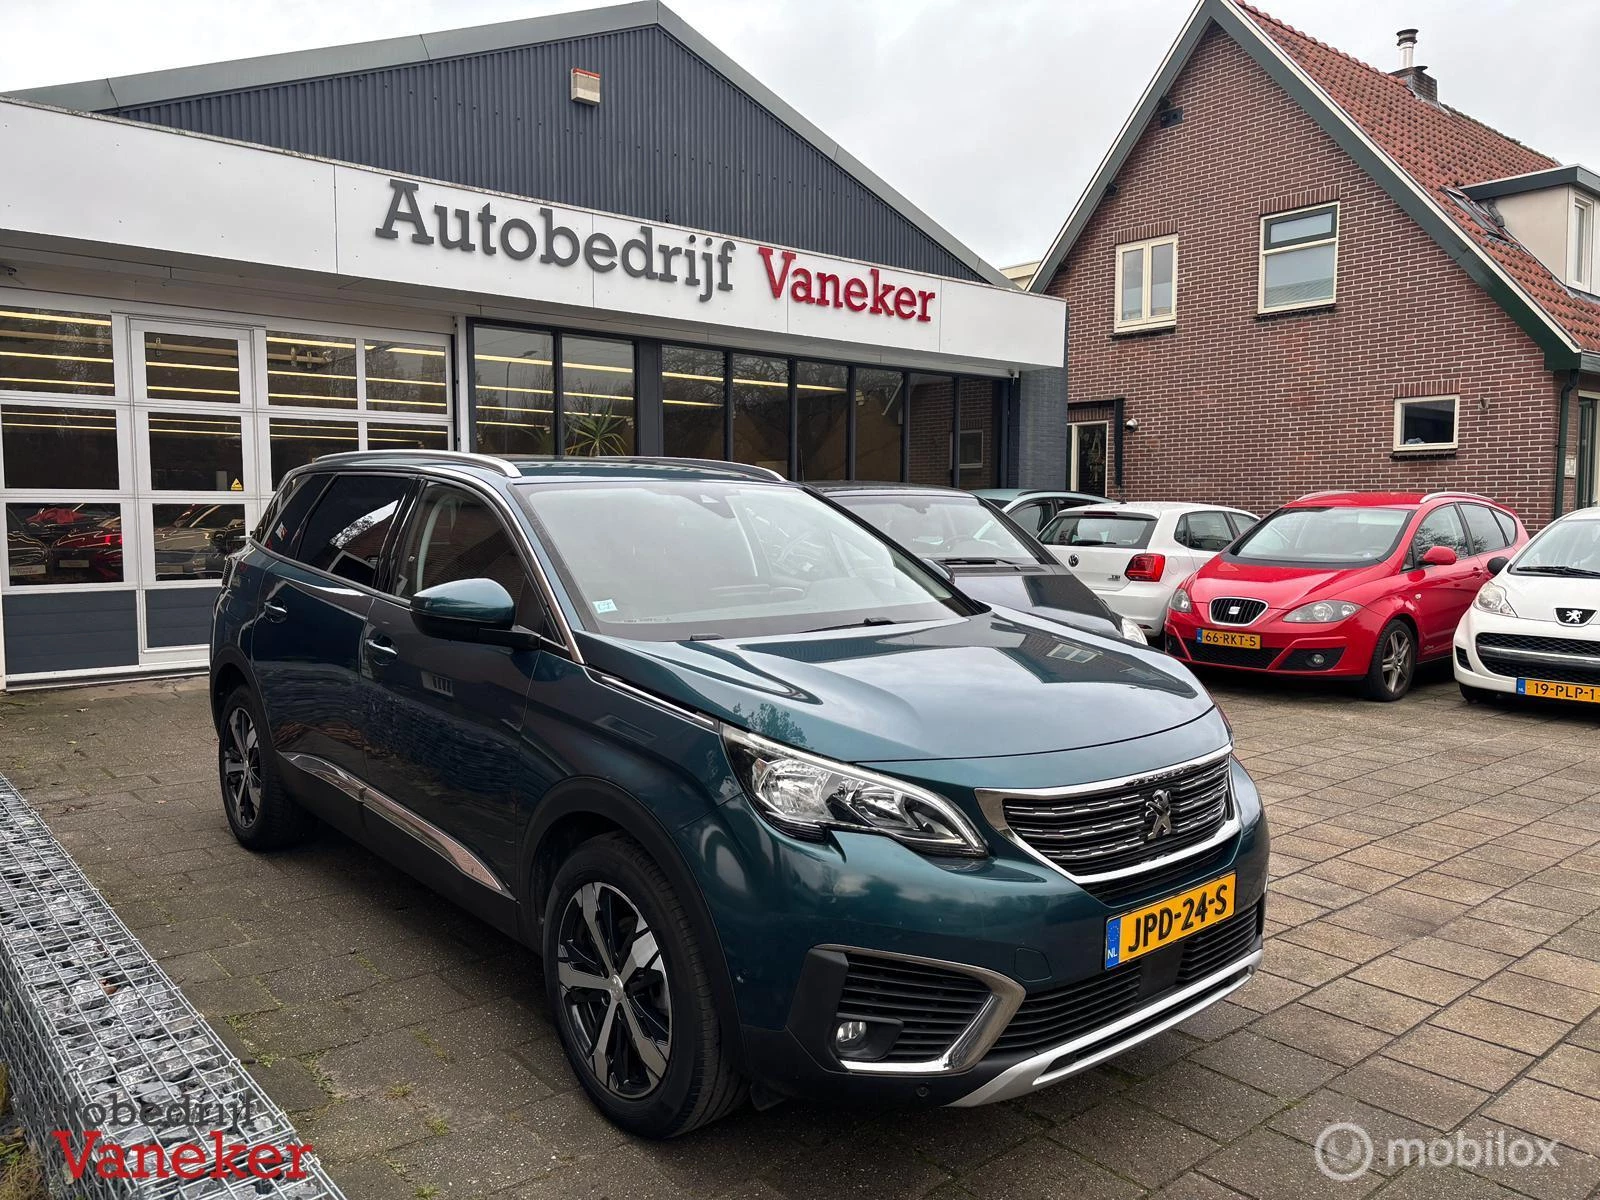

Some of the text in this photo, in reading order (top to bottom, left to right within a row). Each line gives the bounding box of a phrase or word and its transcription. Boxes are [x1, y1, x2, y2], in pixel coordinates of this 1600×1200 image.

[375, 178, 936, 322] Autobedrijf Vaneker
[1205, 632, 1257, 647] 66-RKT-5
[1534, 682, 1595, 700] 19-PLP-1
[1128, 884, 1228, 953] JPD-24-S
[1107, 947, 1118, 960] NL
